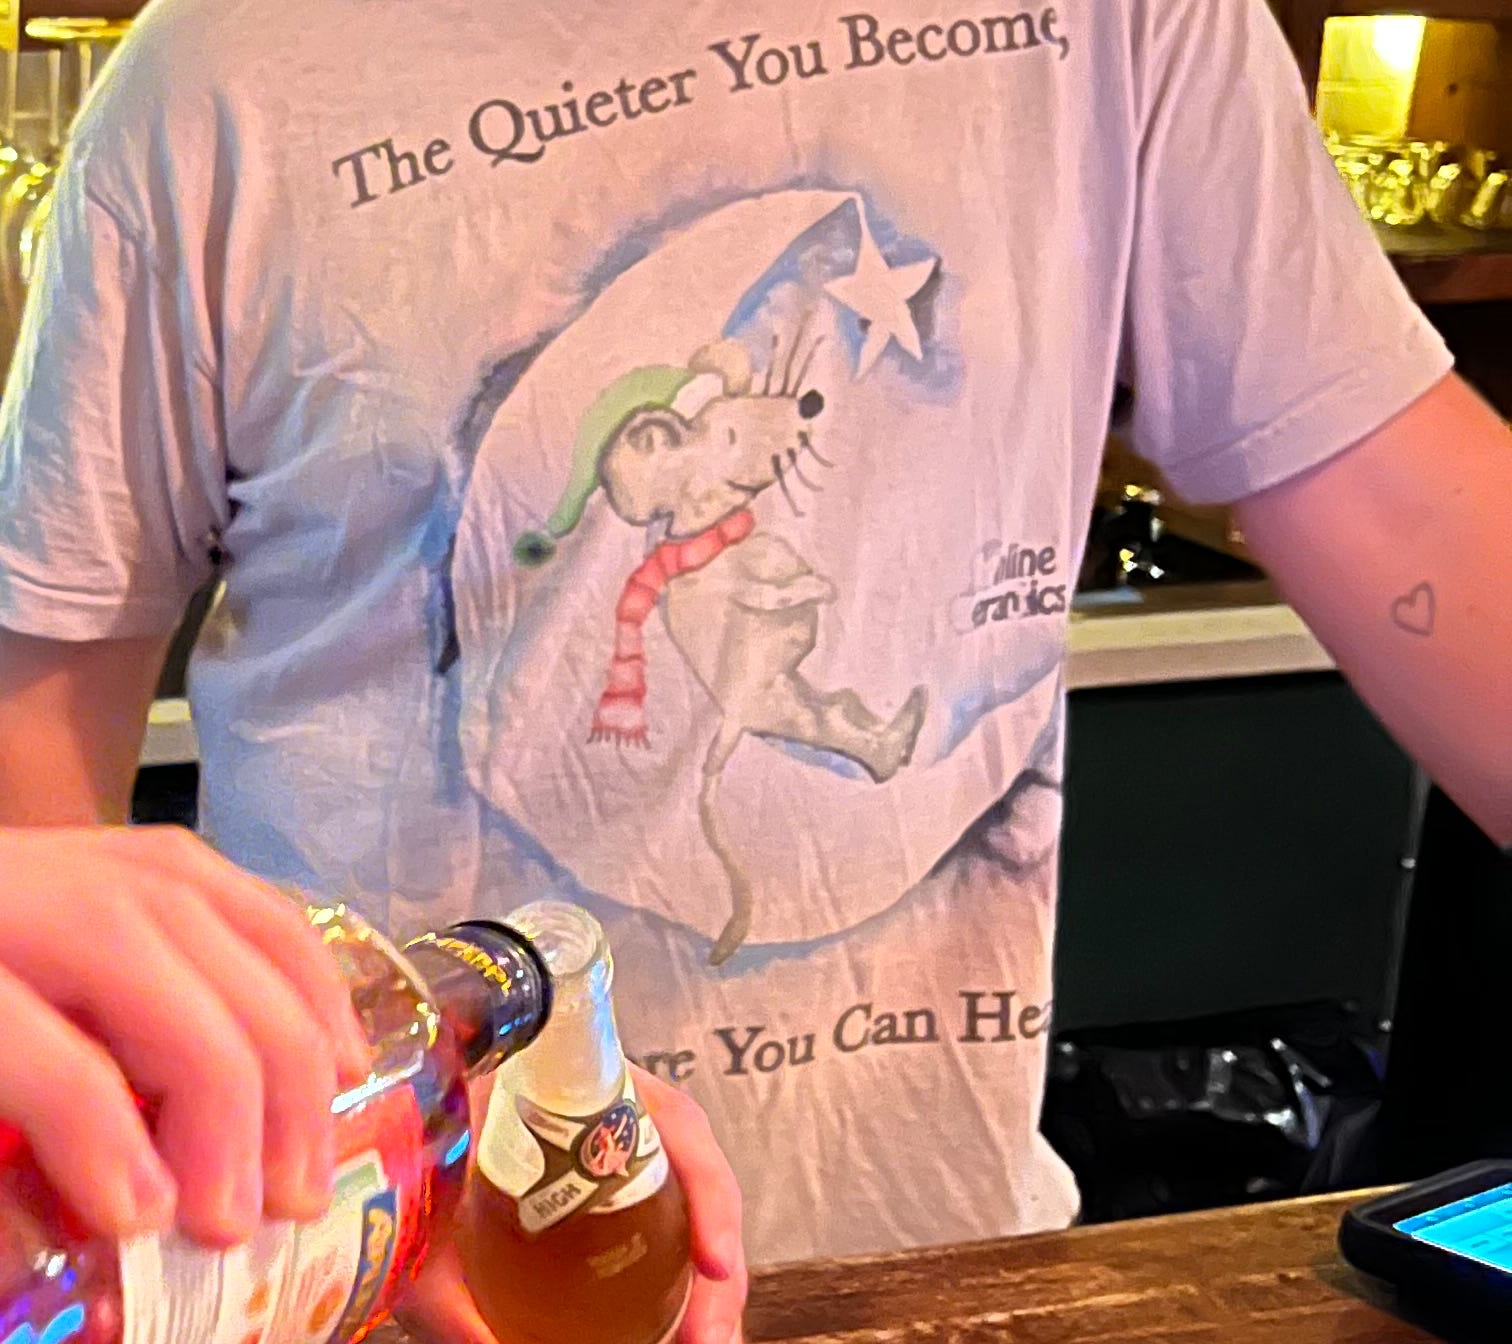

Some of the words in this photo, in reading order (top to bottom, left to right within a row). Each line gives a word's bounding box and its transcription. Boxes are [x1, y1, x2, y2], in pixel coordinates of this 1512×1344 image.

[332, 139, 454, 209] The
[469, 65, 697, 168] Quieter
[708, 30, 827, 95] You
[713, 1025, 815, 1077] You
[832, 1002, 939, 1054] Can
